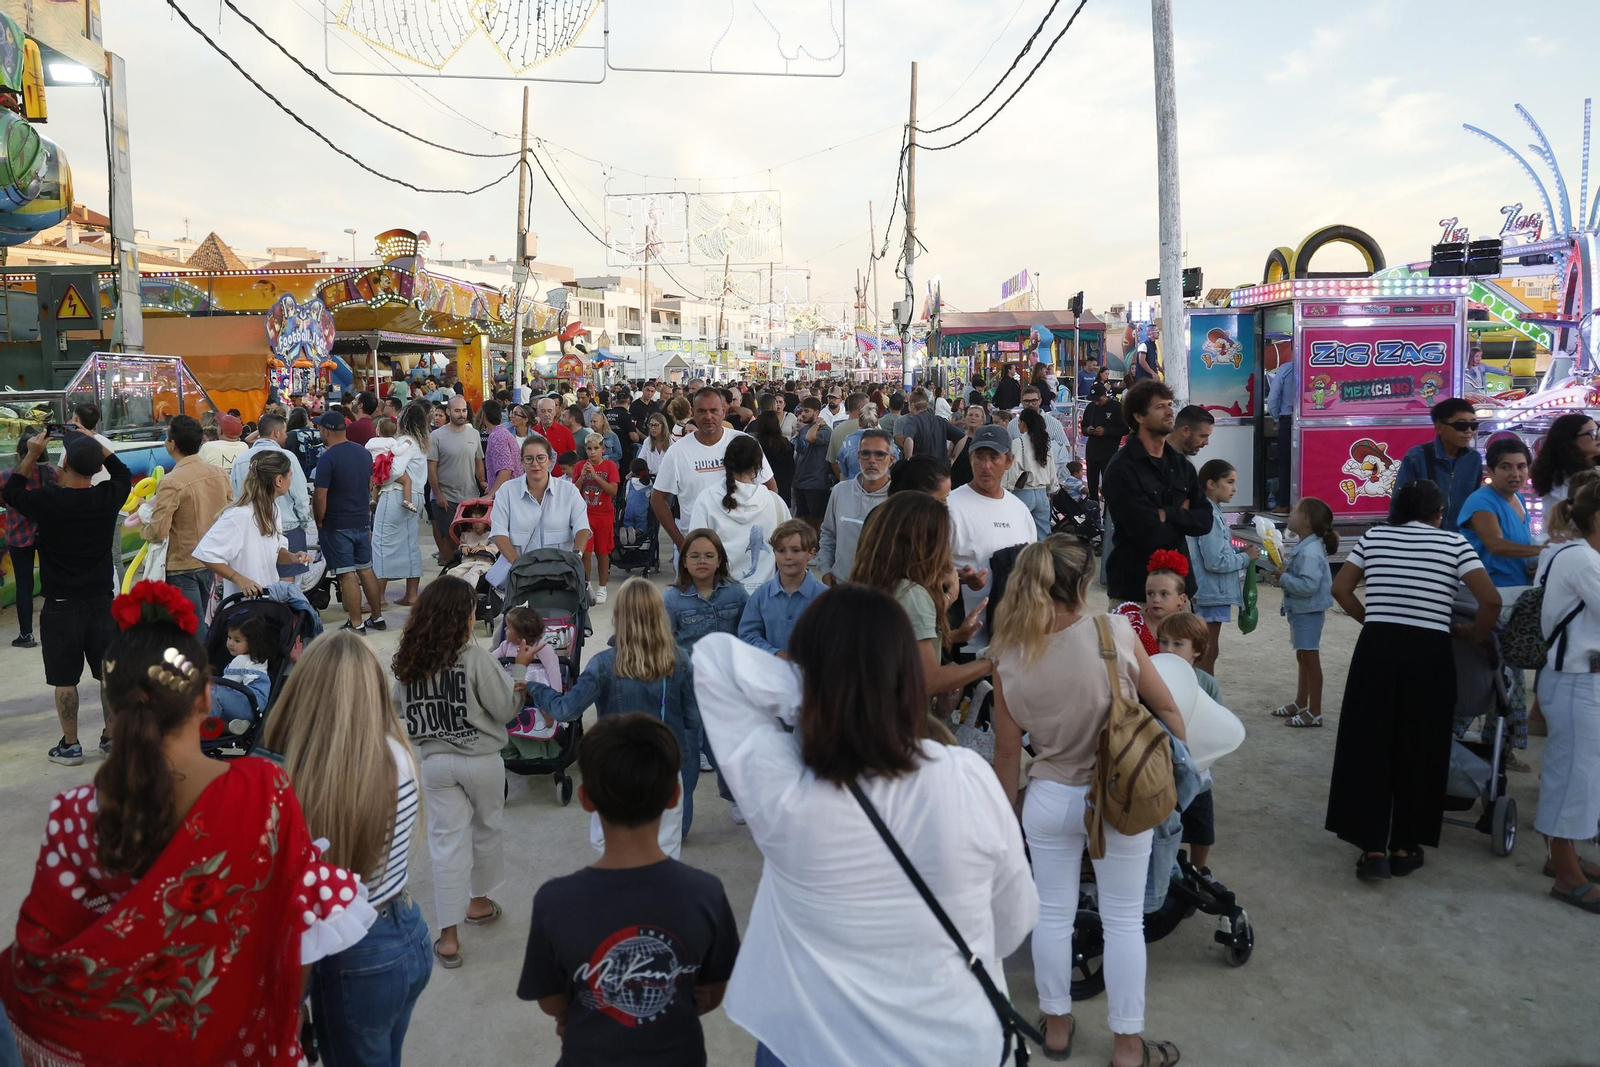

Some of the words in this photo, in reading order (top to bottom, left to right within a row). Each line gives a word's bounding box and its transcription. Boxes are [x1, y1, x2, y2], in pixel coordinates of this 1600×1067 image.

[1499, 203, 1543, 243] Zag
[279, 329, 311, 348] Football
[1374, 340, 1446, 366] ZAG
[1344, 383, 1410, 398] MEXICANO
[694, 458, 724, 469] HURLE
